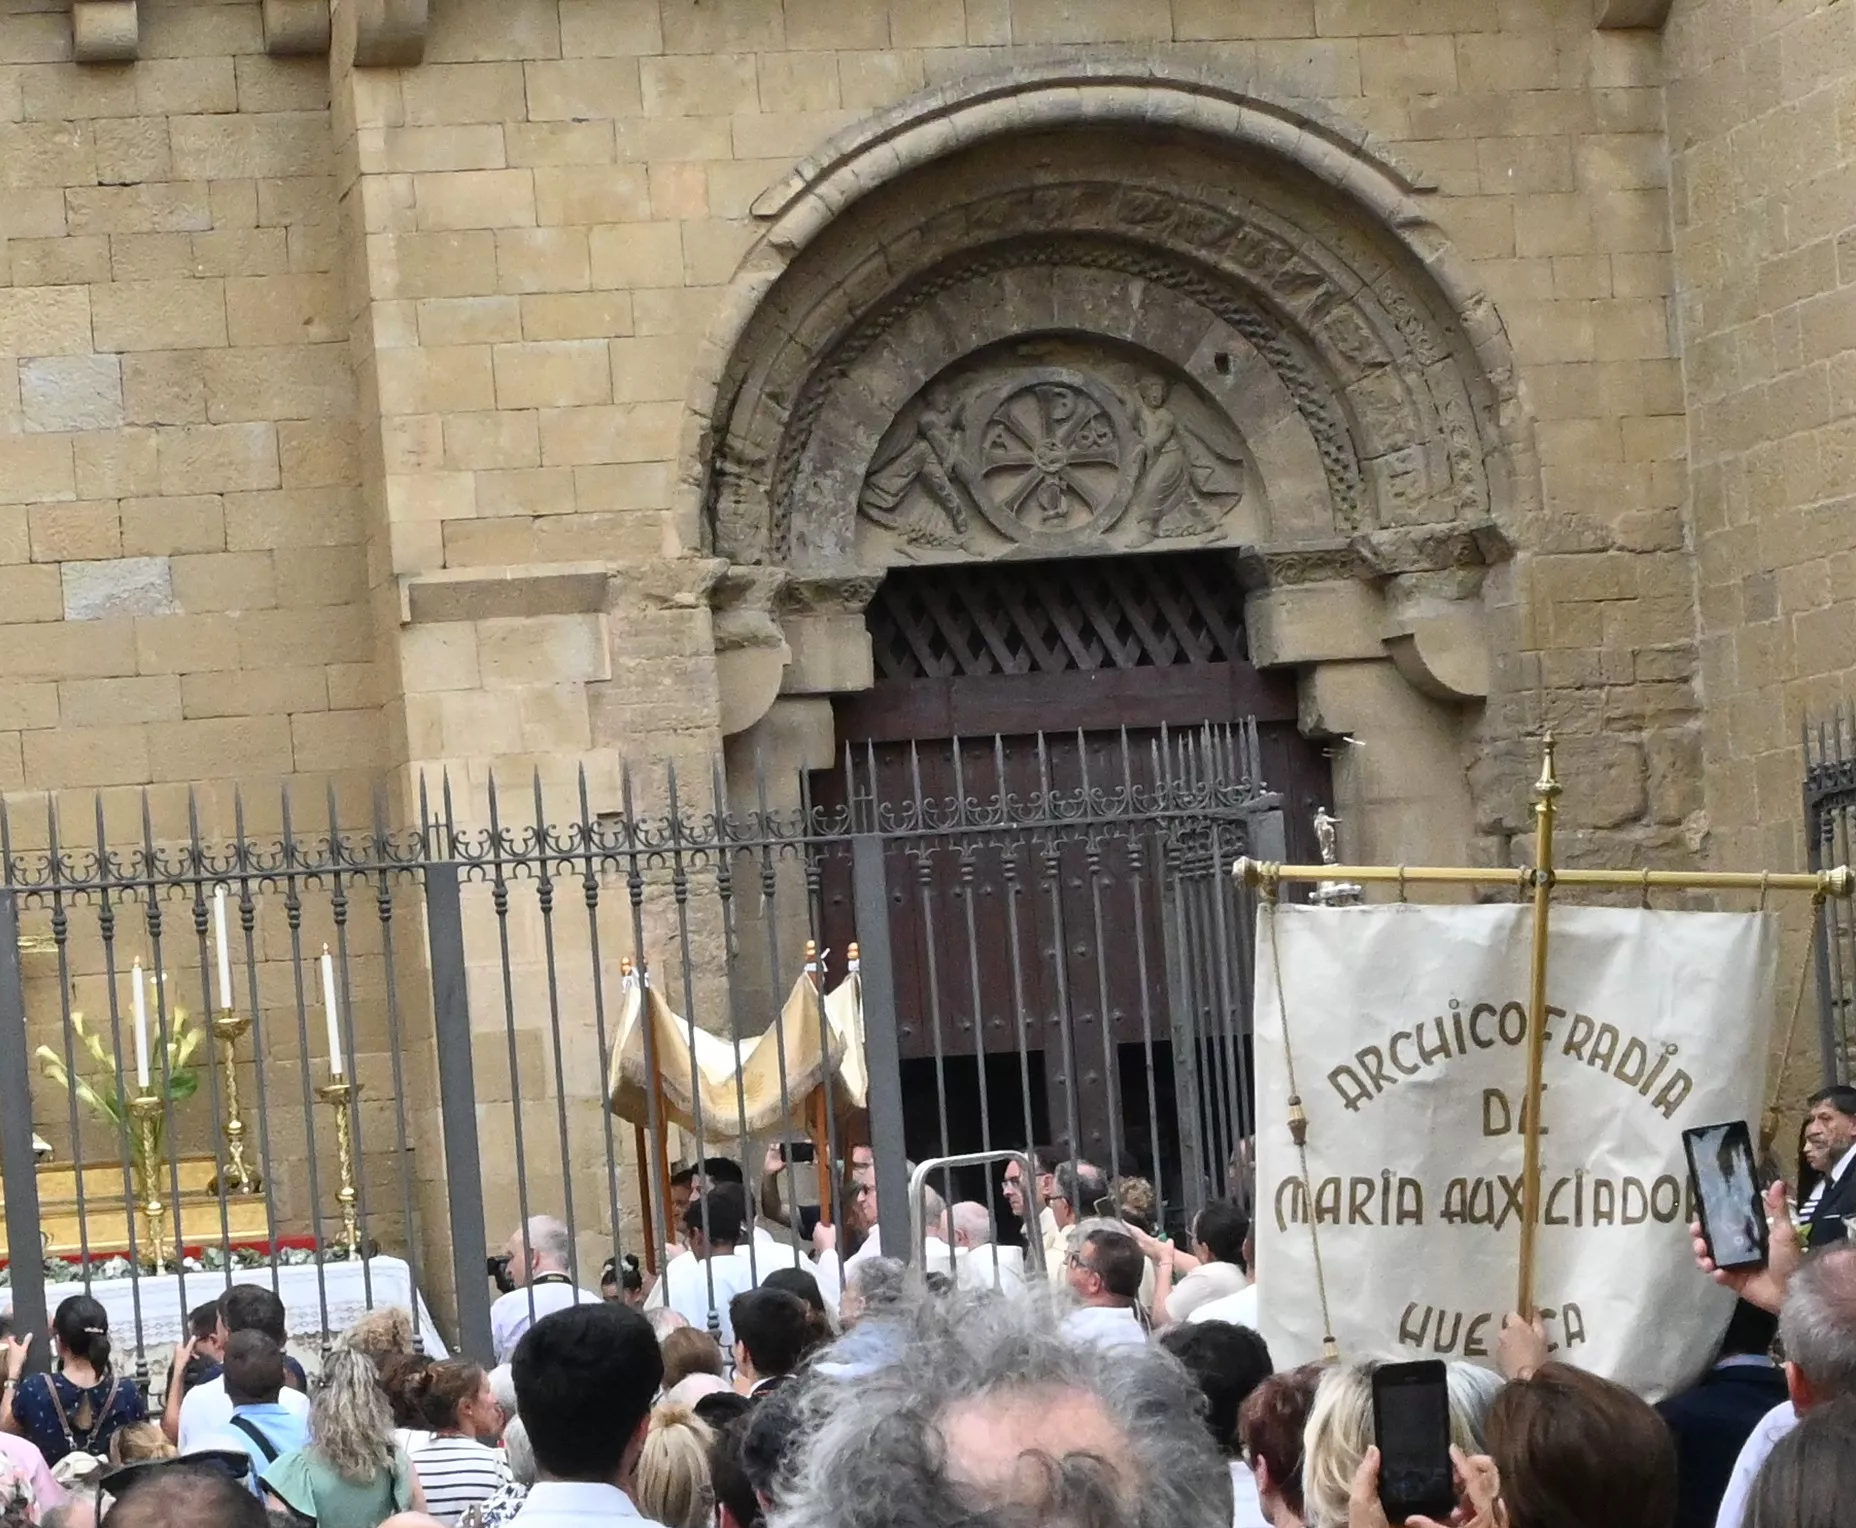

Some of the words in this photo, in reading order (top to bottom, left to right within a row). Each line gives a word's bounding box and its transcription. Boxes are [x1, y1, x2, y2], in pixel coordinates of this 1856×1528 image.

[1274, 1167, 1423, 1233] MARIA
[1440, 1166, 1697, 1232] AUXLIADO
[1399, 1302, 1586, 1356] HUEA
